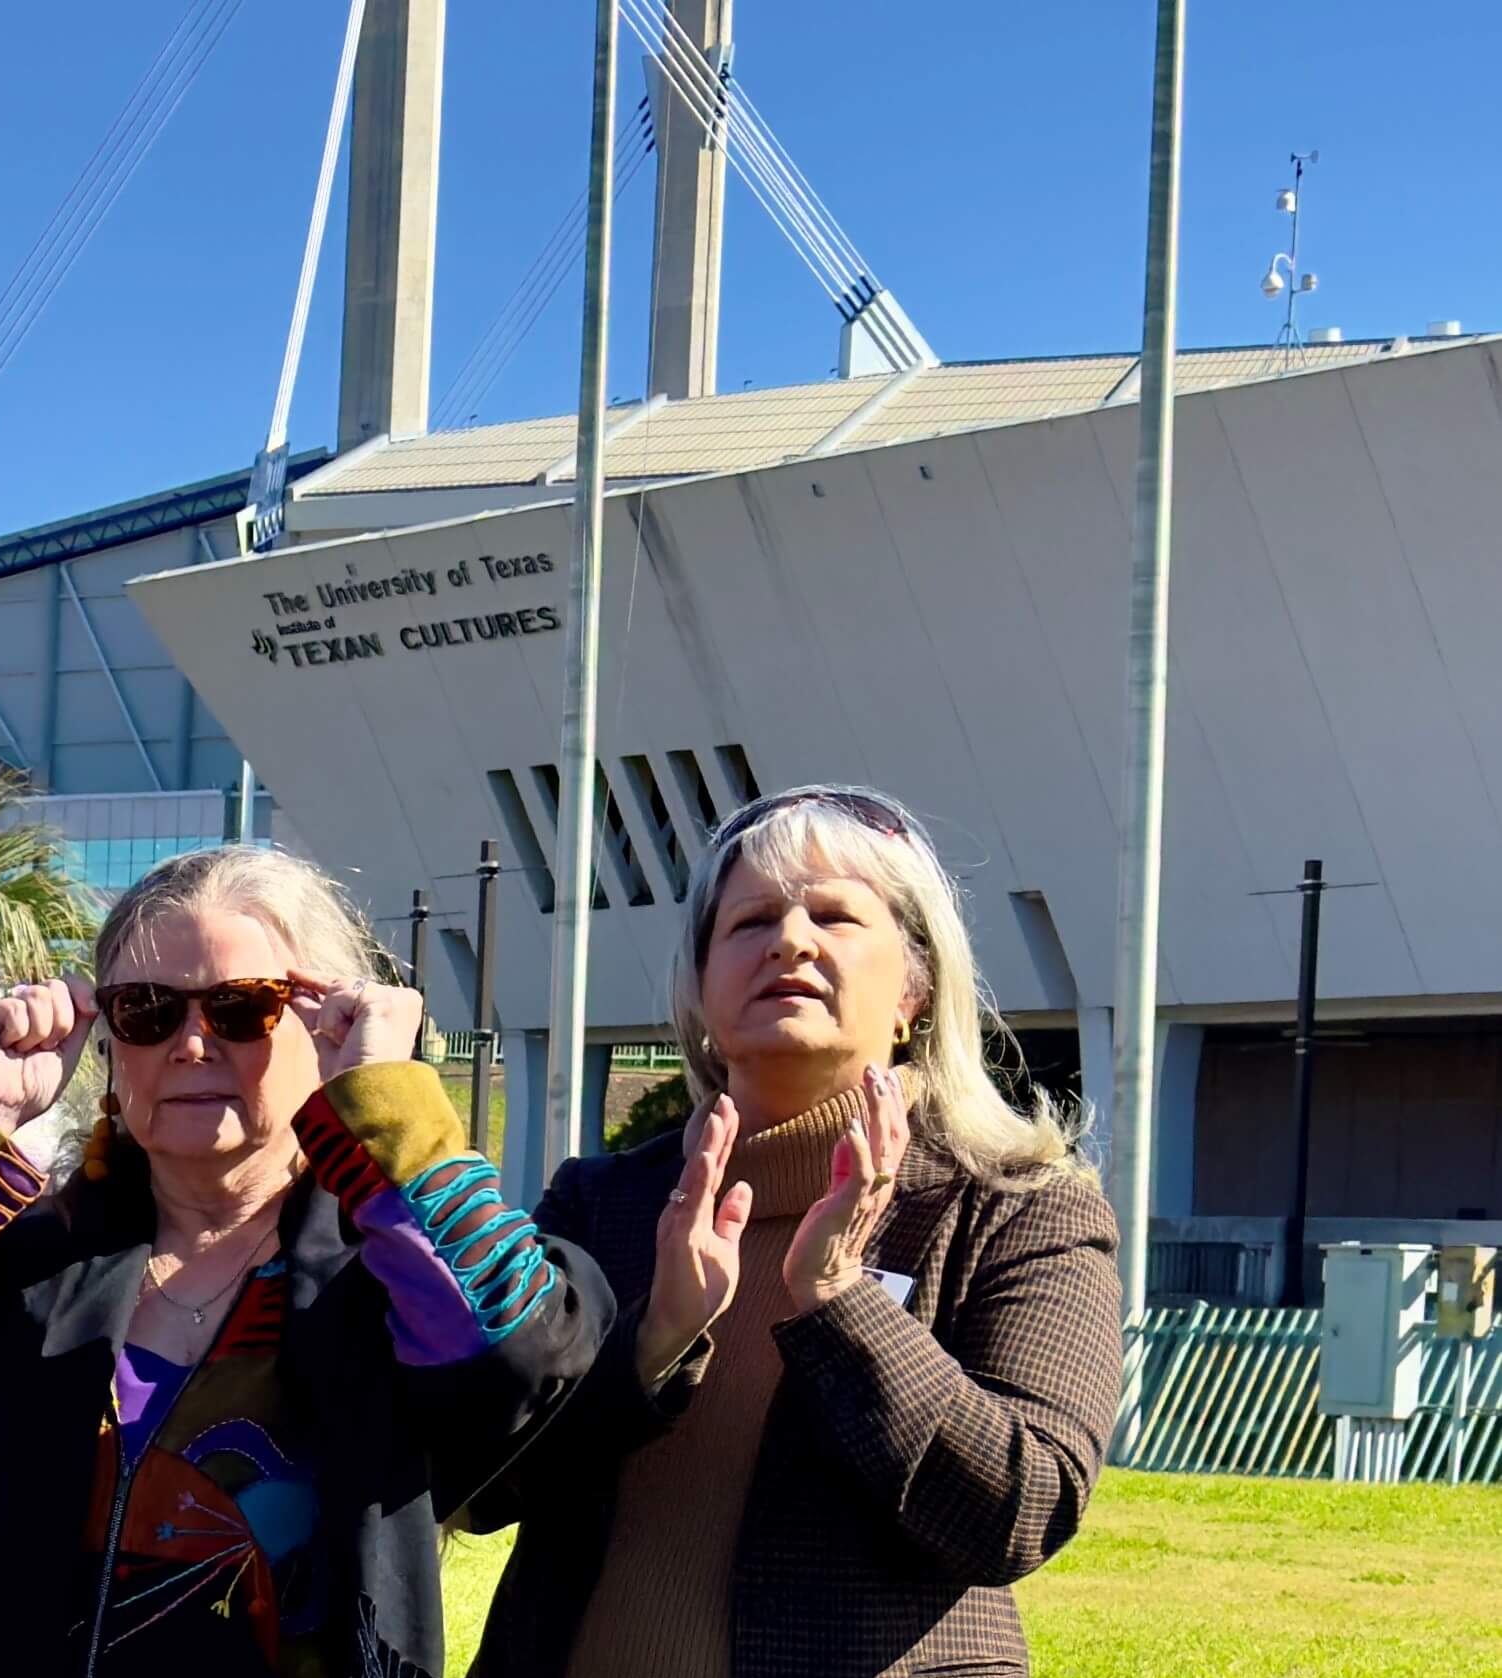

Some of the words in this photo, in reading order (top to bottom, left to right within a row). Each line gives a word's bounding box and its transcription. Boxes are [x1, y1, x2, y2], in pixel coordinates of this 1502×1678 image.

[262, 592, 311, 617] The
[316, 568, 437, 608] University
[448, 560, 472, 587] of
[479, 553, 555, 582] Texas
[281, 632, 385, 667] TEXAN
[400, 606, 563, 650] CULTURES
